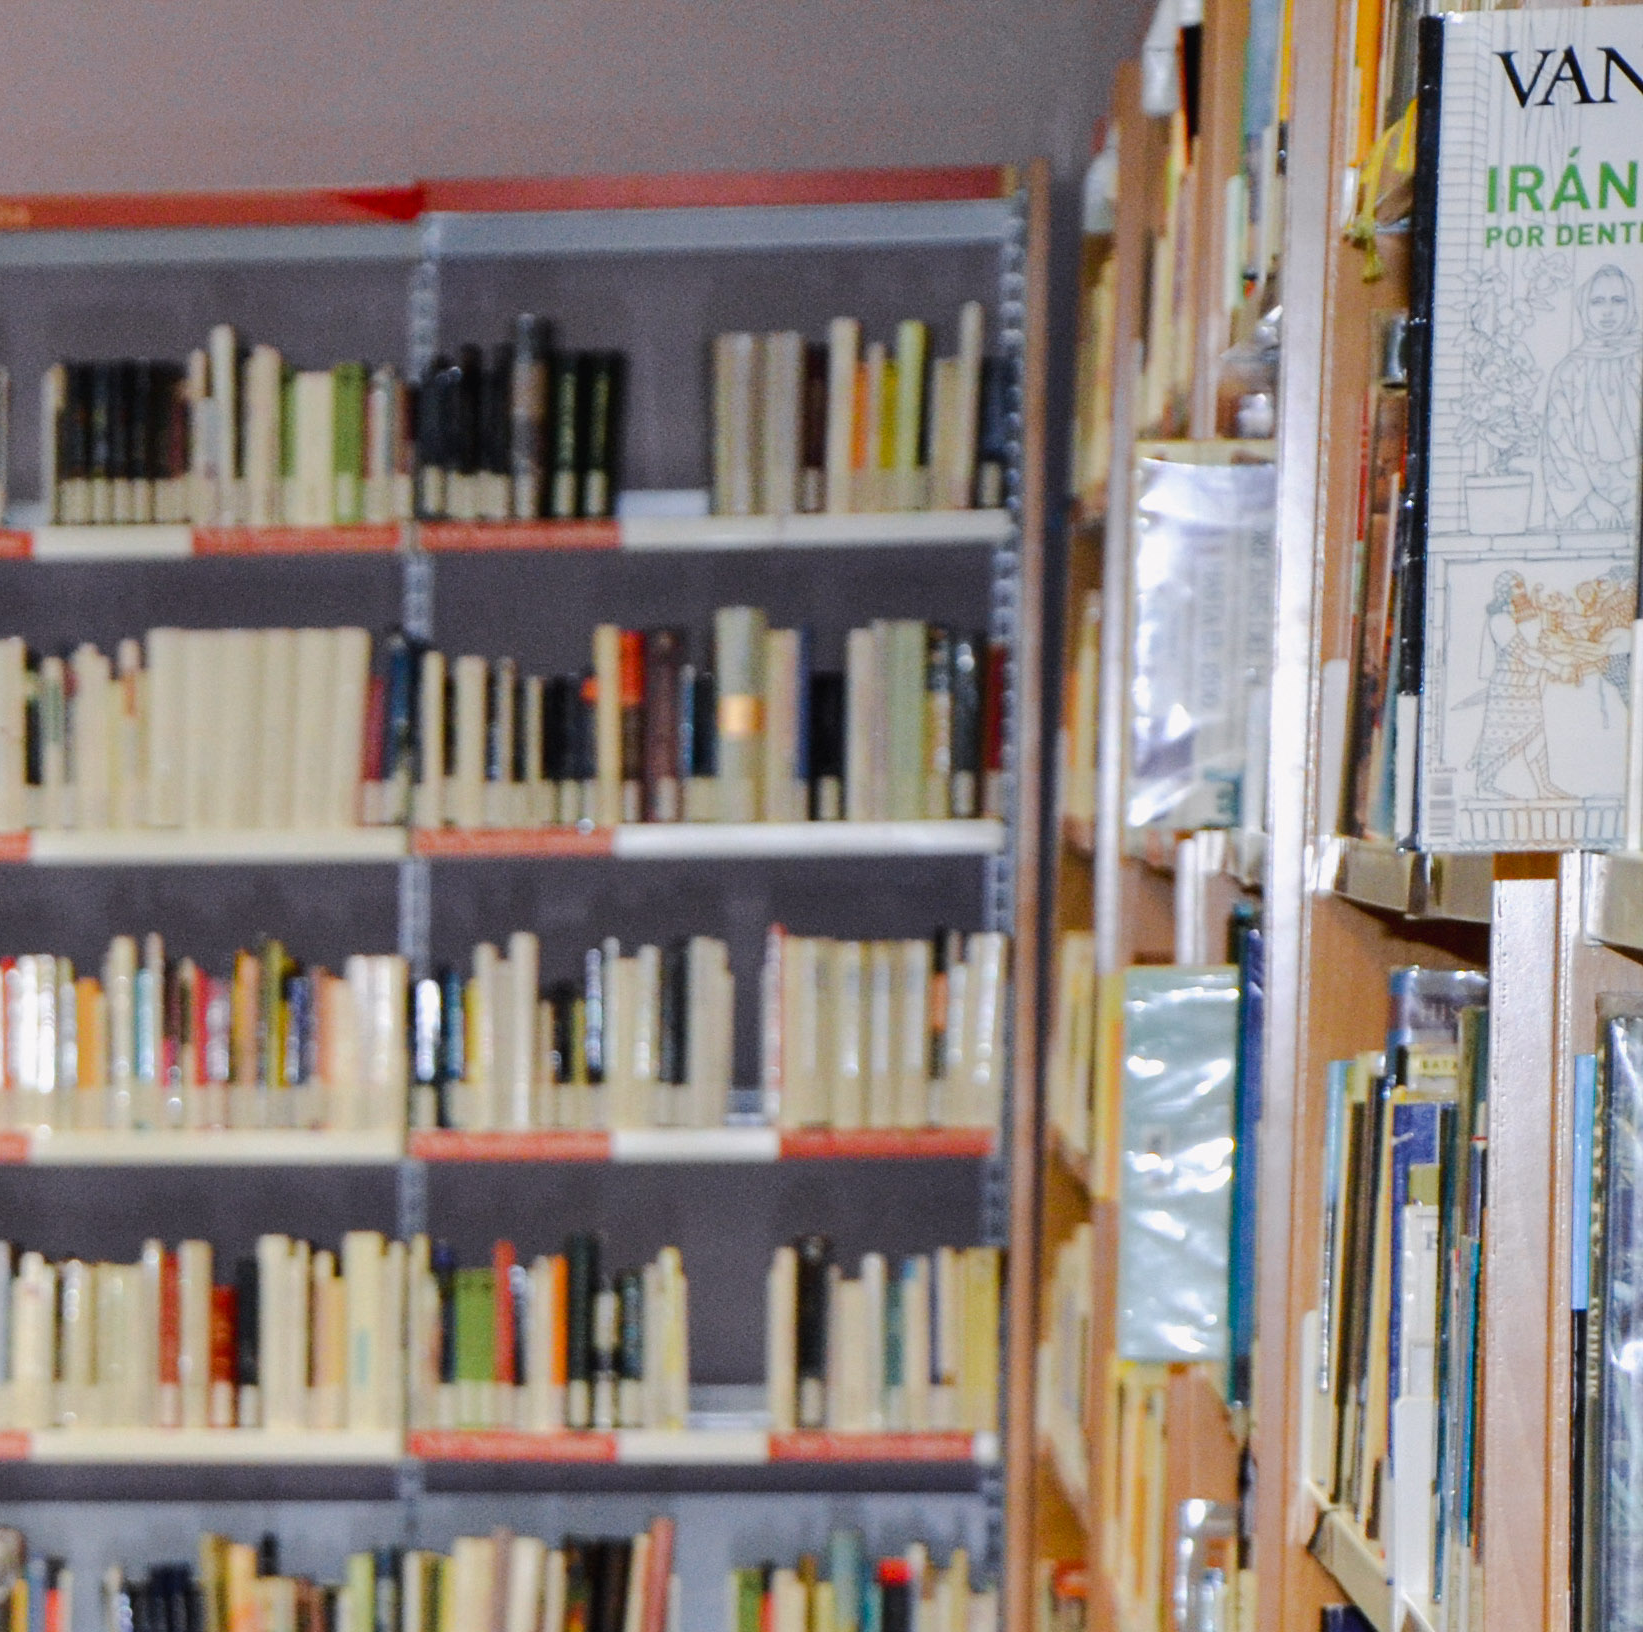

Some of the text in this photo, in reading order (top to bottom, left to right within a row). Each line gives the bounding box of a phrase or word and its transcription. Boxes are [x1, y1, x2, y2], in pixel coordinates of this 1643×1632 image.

[1487, 147, 1639, 213] IRÁN
[1486, 222, 1643, 248] POR DENT
